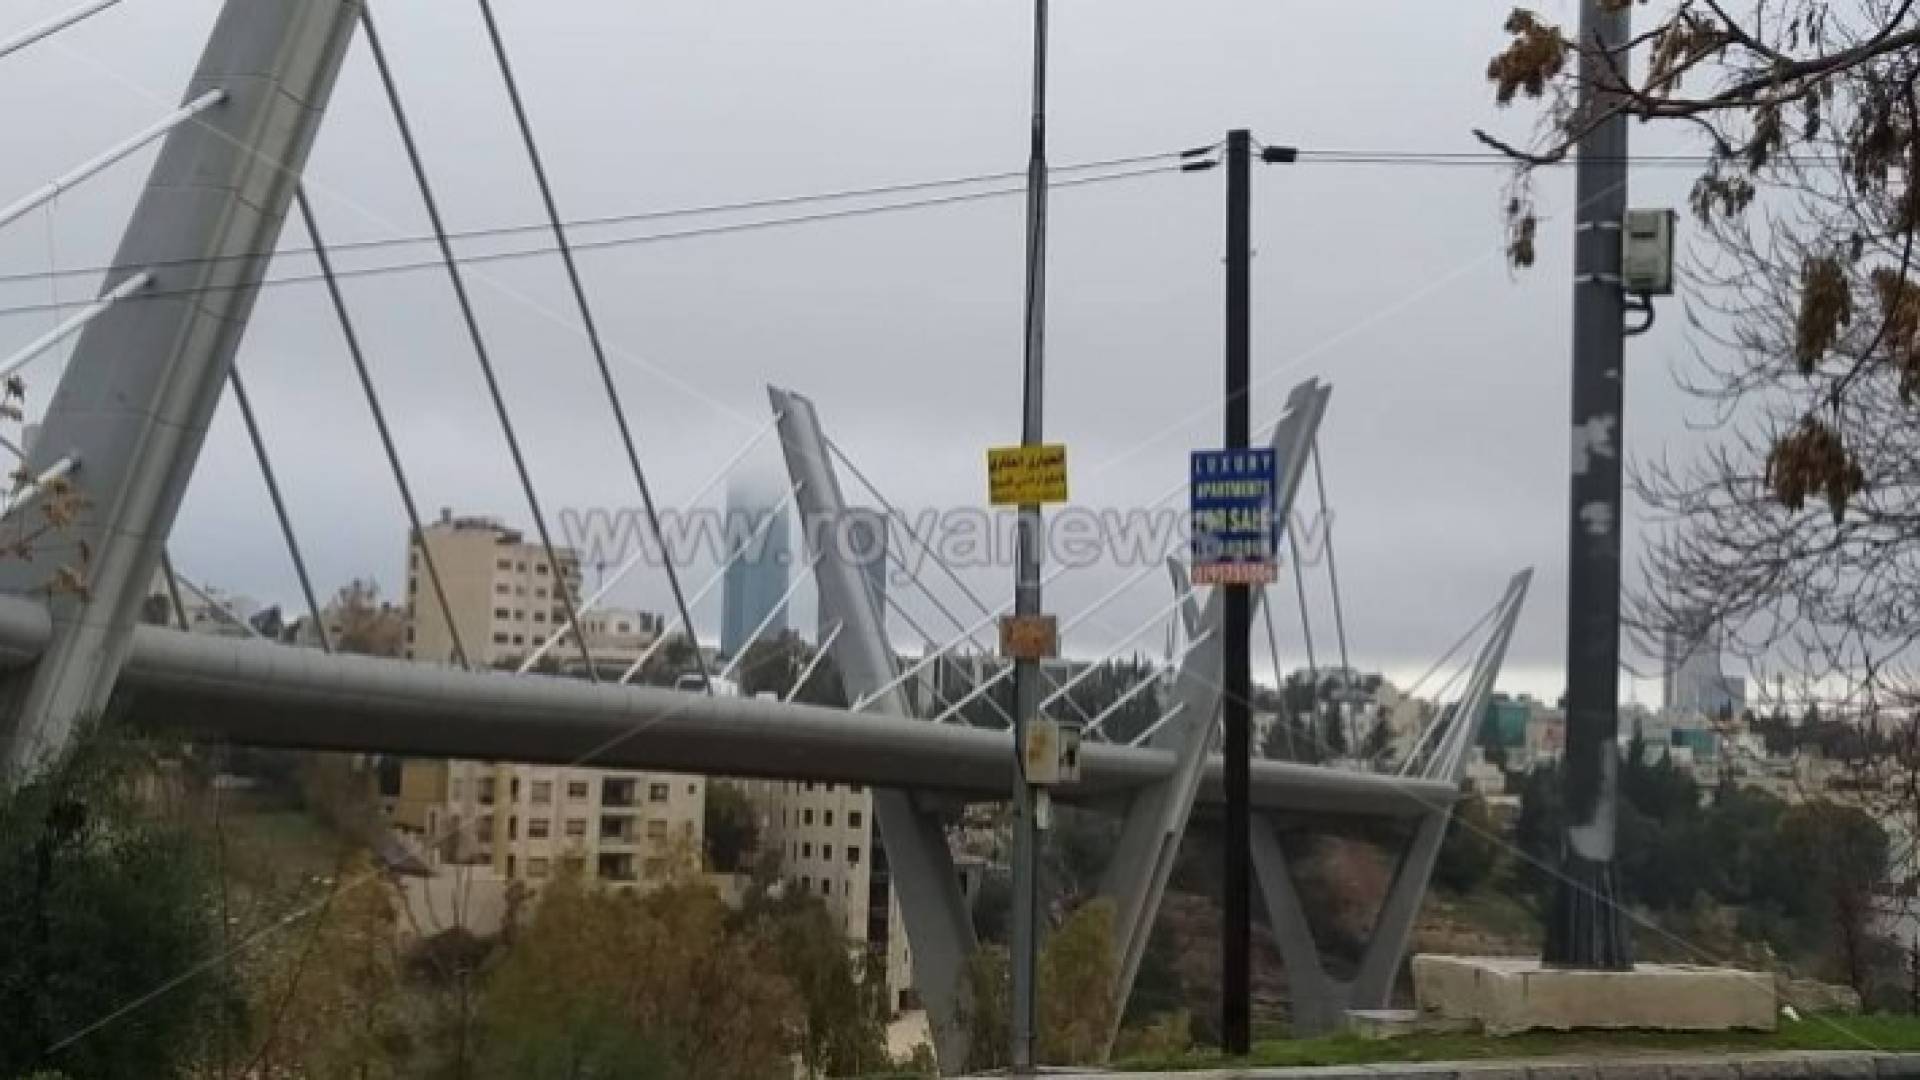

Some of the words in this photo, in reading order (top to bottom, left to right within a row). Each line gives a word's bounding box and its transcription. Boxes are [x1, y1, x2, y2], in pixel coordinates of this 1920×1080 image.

[1194, 454, 1271, 473] LUXURY
[1195, 480, 1271, 498] APARTMENTS
[1230, 506, 1271, 530] SALE
